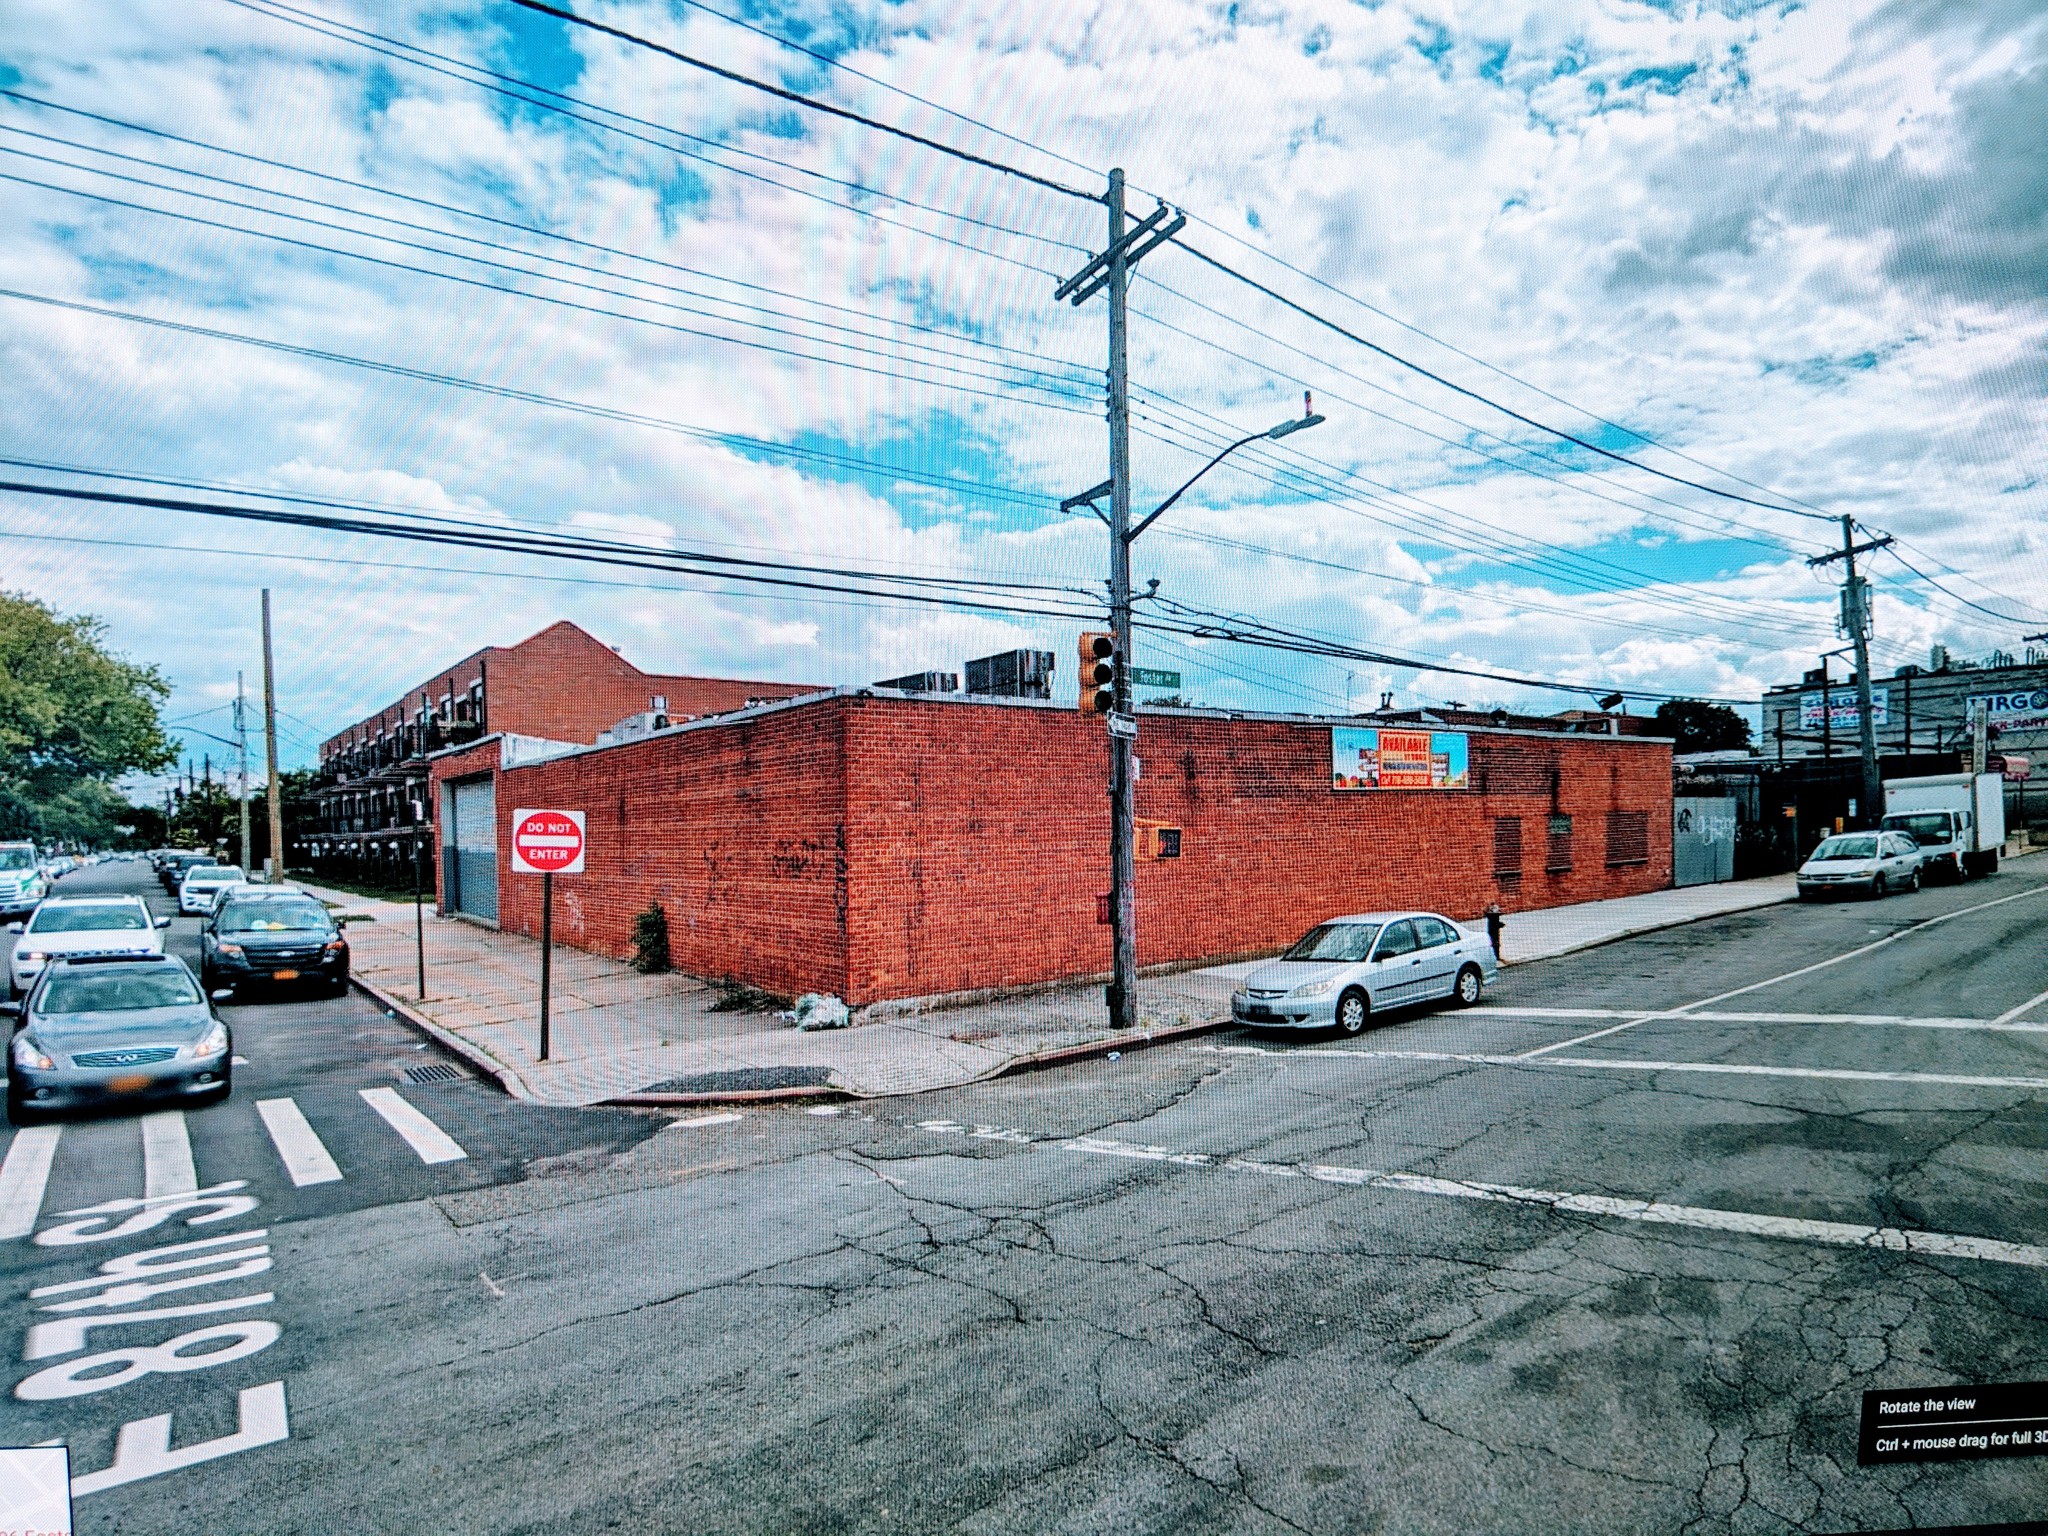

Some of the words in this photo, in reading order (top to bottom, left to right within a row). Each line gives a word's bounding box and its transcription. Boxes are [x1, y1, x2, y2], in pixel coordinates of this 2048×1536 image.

[1383, 737, 1428, 752] AVAILABLE
[527, 822, 544, 832] DO
[548, 823, 572, 833] NOT
[529, 849, 568, 860] ENTER
[14, 1229, 283, 1401] 87th
[1879, 1401, 1921, 1414] Rotate
[1923, 1398, 1945, 1412] the
[1947, 1398, 1976, 1410] view
[1876, 1438, 1899, 1452] Ctrl
[1902, 1440, 1910, 1449] +
[1913, 1438, 1956, 1450] mouse
[1959, 1434, 1988, 1449] drag
[1991, 1431, 2010, 1446] for
[2011, 1430, 2032, 1445] full
